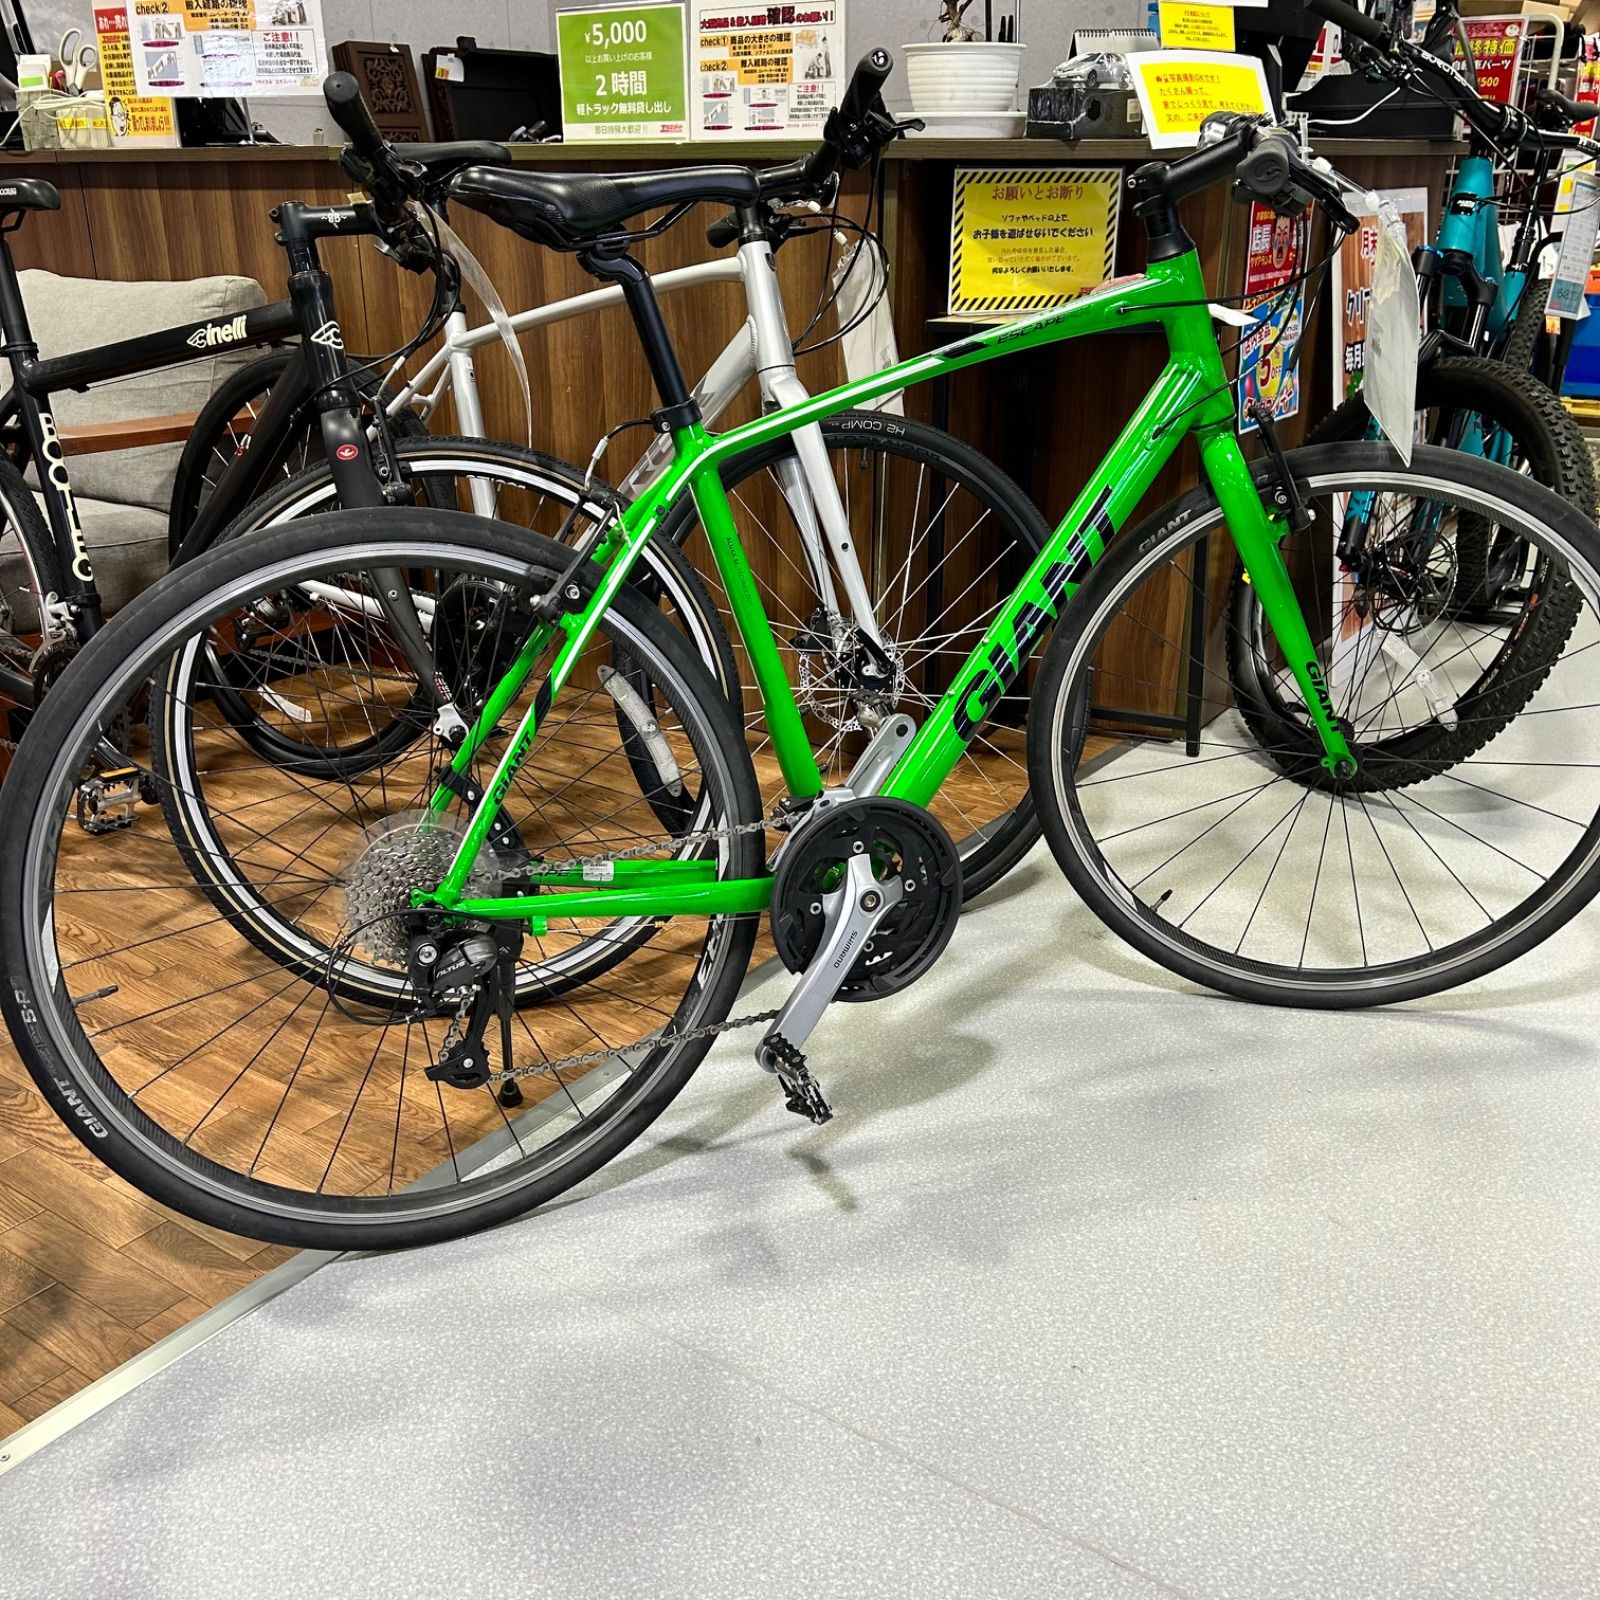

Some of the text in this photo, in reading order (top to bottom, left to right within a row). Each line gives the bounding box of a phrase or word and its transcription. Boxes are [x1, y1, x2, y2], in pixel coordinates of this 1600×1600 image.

[136, 2, 169, 15] check 2
[584, 20, 648, 50] ¥5,000
[700, 37, 720, 47] check
[730, 32, 792, 45] 商品の大きさの確認
[585, 51, 653, 64] 以上お買い上げのお客様
[700, 61, 727, 72] check 2
[576, 101, 672, 116] 軽トラック無料貸し出し
[991, 184, 1085, 201] お願いとお断り
[972, 227, 1094, 241] お子様を遊ばせないでください
[997, 315, 1065, 345] ESCAPE
[1344, 342, 1365, 372] 毎月
[841, 419, 881, 431] COMP
[886, 423, 906, 436] H2
[38, 412, 95, 582] BOOTLEG
[1138, 509, 1192, 553] GIANT
[953, 483, 1118, 743] GIANT
[1305, 661, 1341, 732] GIANT
[492, 730, 533, 807] GIANT
[833, 929, 859, 969] SHIMANO
[436, 959, 466, 979] ALTUS
[53, 1076, 109, 1139] GIANT
